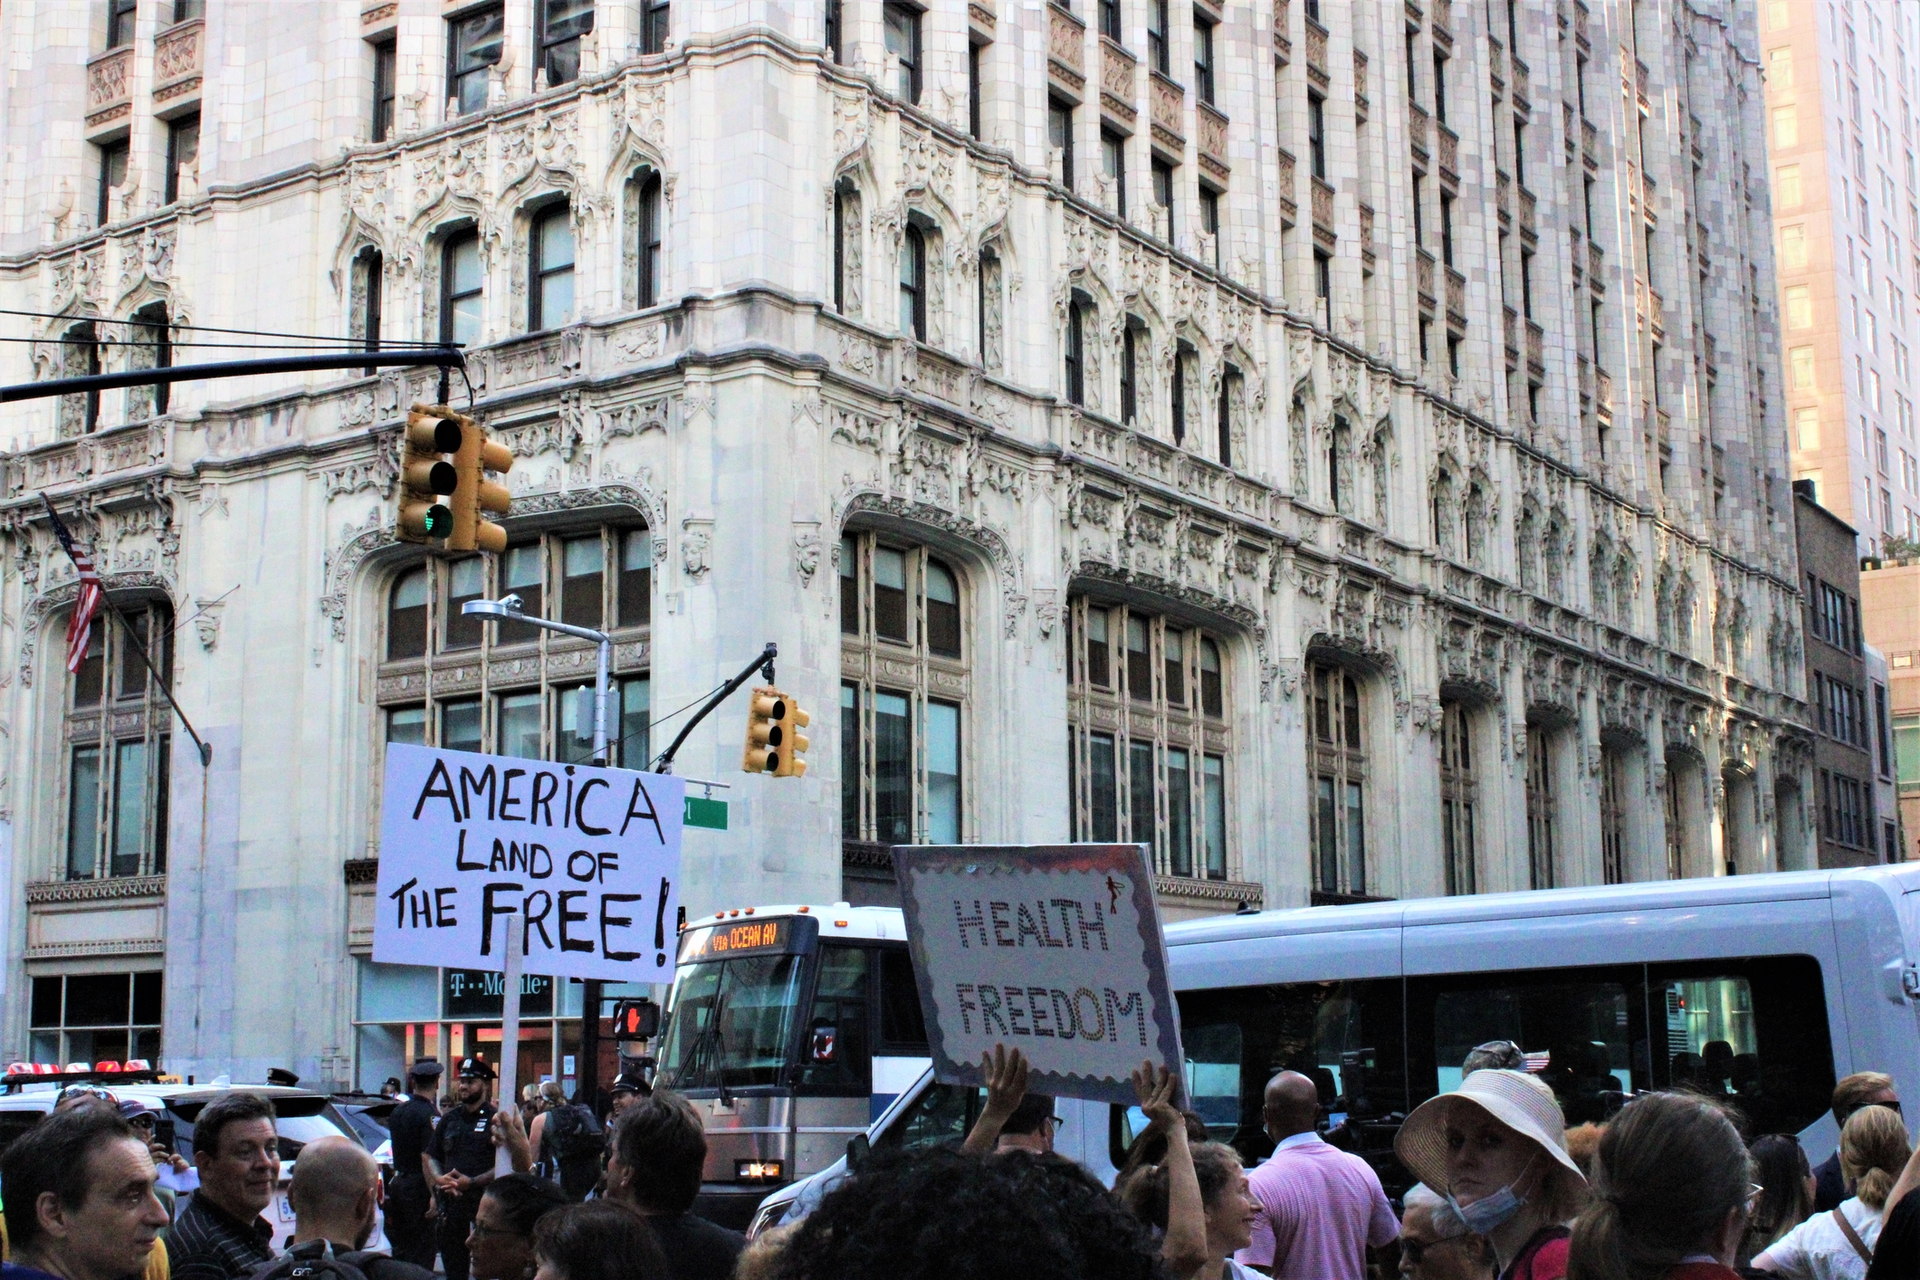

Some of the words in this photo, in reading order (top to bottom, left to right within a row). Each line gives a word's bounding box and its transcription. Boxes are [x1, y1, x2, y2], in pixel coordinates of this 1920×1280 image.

[456, 828, 553, 880] LAND
[567, 849, 619, 884] OF
[388, 877, 458, 929] THE
[480, 876, 670, 968] FREE!
[713, 935, 729, 952] VIA
[730, 924, 761, 950] OCEAN
[763, 922, 777, 946] AV
[953, 898, 1109, 951] HEALTH
[955, 983, 1148, 1047] FREEDOM
